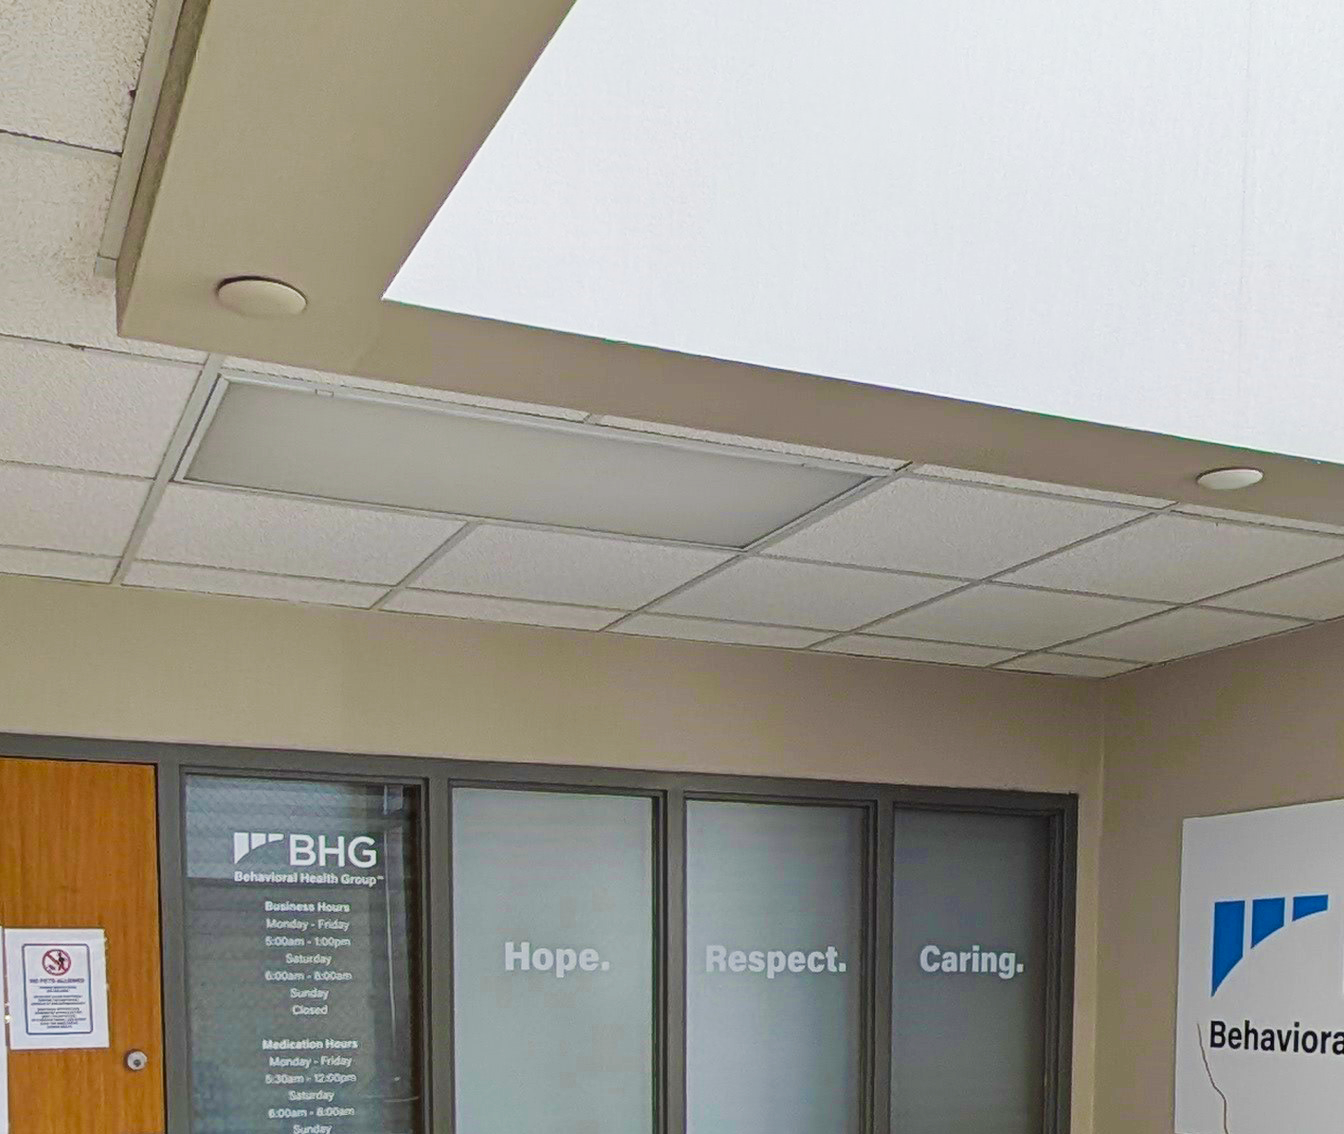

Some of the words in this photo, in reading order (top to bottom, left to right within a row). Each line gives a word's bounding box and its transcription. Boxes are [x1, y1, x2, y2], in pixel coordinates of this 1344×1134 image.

[290, 834, 377, 868] BHG
[234, 871, 298, 883] Behavioral
[300, 872, 338, 885] Health
[341, 874, 377, 888] Group
[264, 900, 316, 912] Business
[317, 902, 351, 912] Hours
[266, 918, 309, 931] Monday
[318, 919, 350, 932] Friday
[285, 953, 332, 966] Saturday
[504, 941, 610, 978] Hope.
[705, 945, 846, 979] Respect.
[919, 945, 1024, 979] Caring.
[290, 987, 329, 1000] Sunday
[292, 1004, 328, 1015] Closed
[262, 1039, 323, 1050] Medication
[325, 1038, 358, 1049] Hours
[269, 1056, 312, 1069] Monday
[321, 1055, 352, 1067] Friday
[288, 1090, 334, 1102] Saturday
[293, 1124, 332, 1134] Sunday
